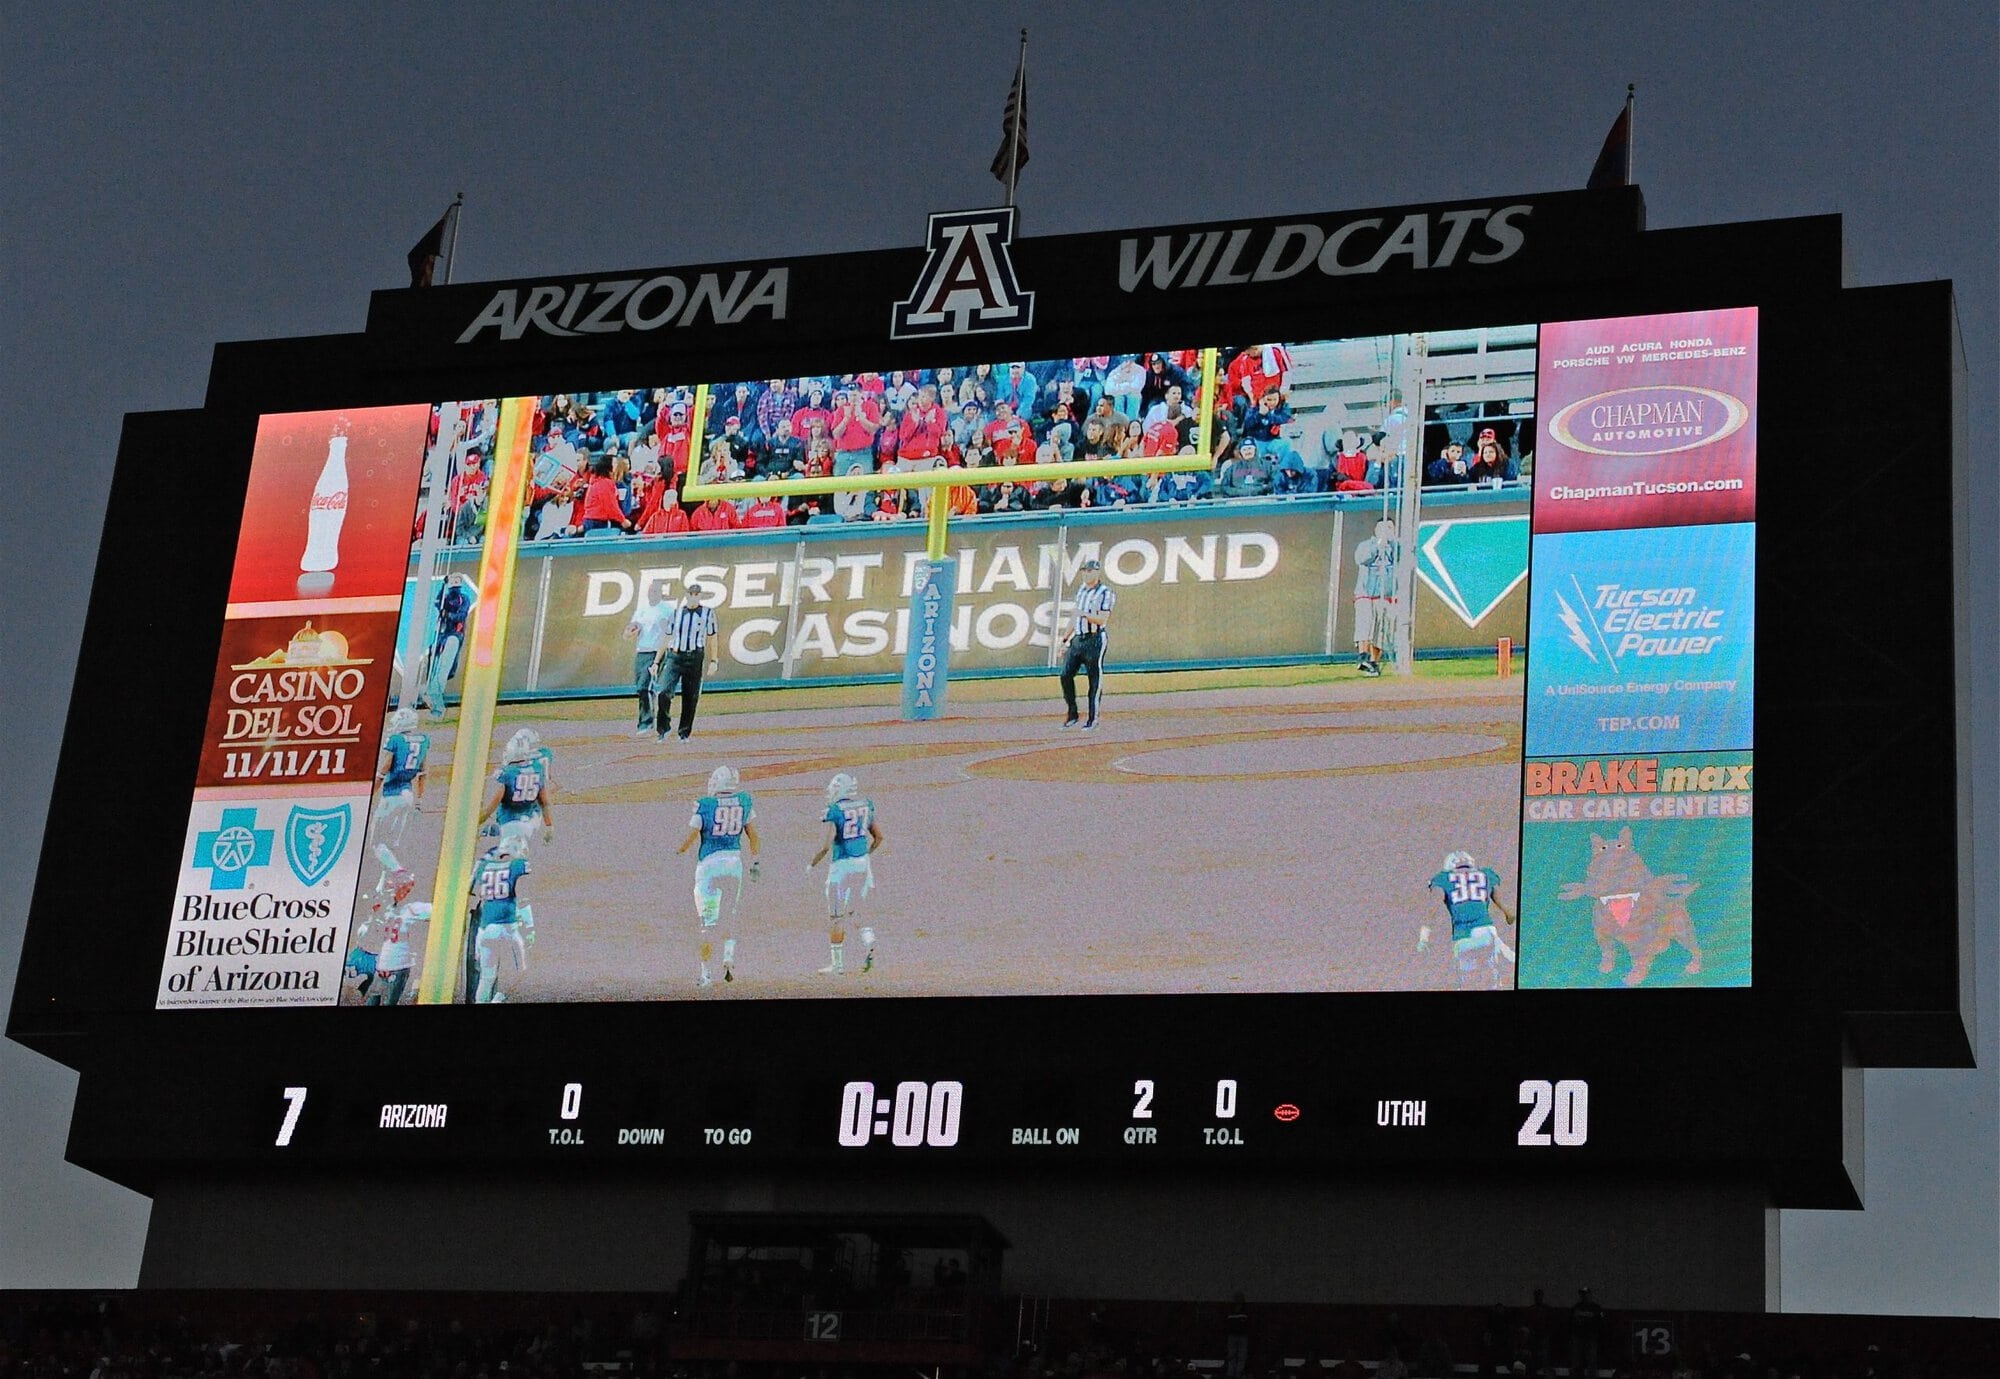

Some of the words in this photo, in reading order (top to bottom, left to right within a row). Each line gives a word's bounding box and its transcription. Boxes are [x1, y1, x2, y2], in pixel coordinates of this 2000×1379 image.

[1118, 204, 1533, 293] WILDCATS
[455, 267, 789, 344] ARIZONA
[1553, 356, 1610, 369] PORSCHE
[1616, 354, 1635, 364] VW
[1642, 346, 1747, 363] MERCEDES-BENZ
[1585, 345, 1615, 356] AUDI
[1621, 341, 1663, 353] ACURA
[1670, 337, 1713, 349] HONDA
[1591, 400, 1704, 429] CHAPMAN
[1592, 425, 1703, 443] AUTOMOTIVE
[1550, 477, 1743, 501] ChapmanTucson.com
[583, 551, 884, 617] DESERT
[1594, 583, 1696, 609] Tucson
[1603, 606, 1725, 633] Electric
[915, 583, 942, 708] ARIZONA
[1616, 633, 1724, 658] Power
[229, 669, 365, 704] CASINO
[1546, 685, 1555, 696] A
[1558, 683, 1623, 696] UniSource
[1627, 681, 1671, 694] Energy
[1674, 679, 1738, 693] Company
[223, 707, 291, 740] DEL
[295, 704, 361, 736] SOL
[1598, 715, 1680, 732] TEP.COM
[223, 749, 346, 778] 11/11/11
[1526, 759, 1658, 796] BRAKE
[1661, 765, 1753, 792] max
[1528, 800, 1574, 819] CAR
[1582, 798, 1641, 818] CARE
[1650, 795, 1750, 817] CENTERS
[481, 870, 510, 900] 26
[1448, 871, 1488, 904] 32
[178, 893, 331, 921] BlueCross
[173, 927, 337, 956] BlueShield
[167, 965, 202, 993] of
[202, 964, 320, 992] Arizona
[561, 1083, 582, 1119] 0
[1132, 1079, 1154, 1119] 2
[1215, 1079, 1237, 1118] 0
[1517, 1079, 1588, 1146] 20
[275, 1087, 307, 1146] 7
[379, 1104, 447, 1128] ARIZONA
[838, 1081, 963, 1147] 0:00
[1377, 1100, 1426, 1126] UTAH
[549, 1128, 585, 1145] T.O.L
[618, 1128, 665, 1145] DOWN
[704, 1128, 725, 1145] TO
[728, 1128, 752, 1145] GO
[1011, 1128, 1052, 1145] BALL
[1055, 1128, 1080, 1145] ON
[1123, 1127, 1157, 1145] QTR
[1203, 1128, 1244, 1146] T.O.L
[808, 1312, 839, 1340] 12
[1635, 1327, 1671, 1356] 13
